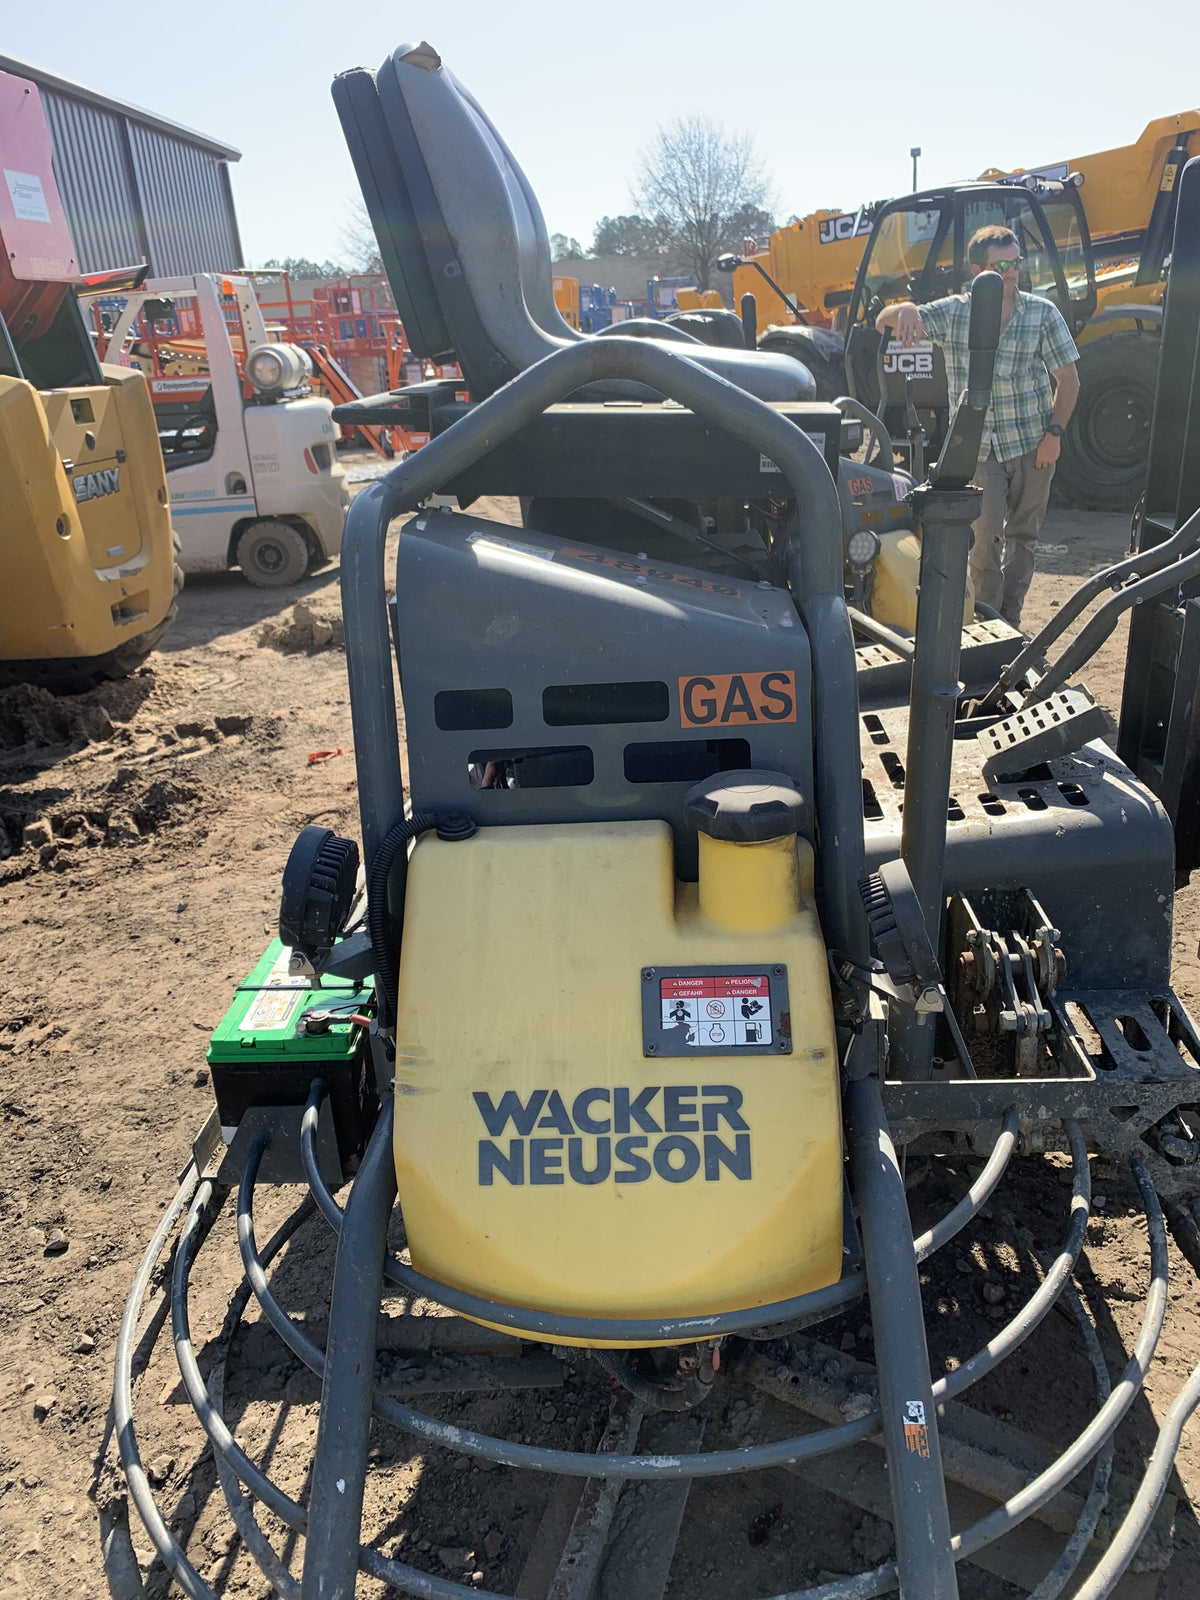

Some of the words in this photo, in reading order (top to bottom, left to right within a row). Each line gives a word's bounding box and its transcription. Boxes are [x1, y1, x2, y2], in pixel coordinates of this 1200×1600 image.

[883, 354, 933, 373] JCB
[73, 466, 120, 502] SANY
[851, 478, 872, 494] GAS
[683, 672, 793, 725] GAS
[472, 1085, 751, 1137] WACKER
[478, 1134, 752, 1186] NEUSON
